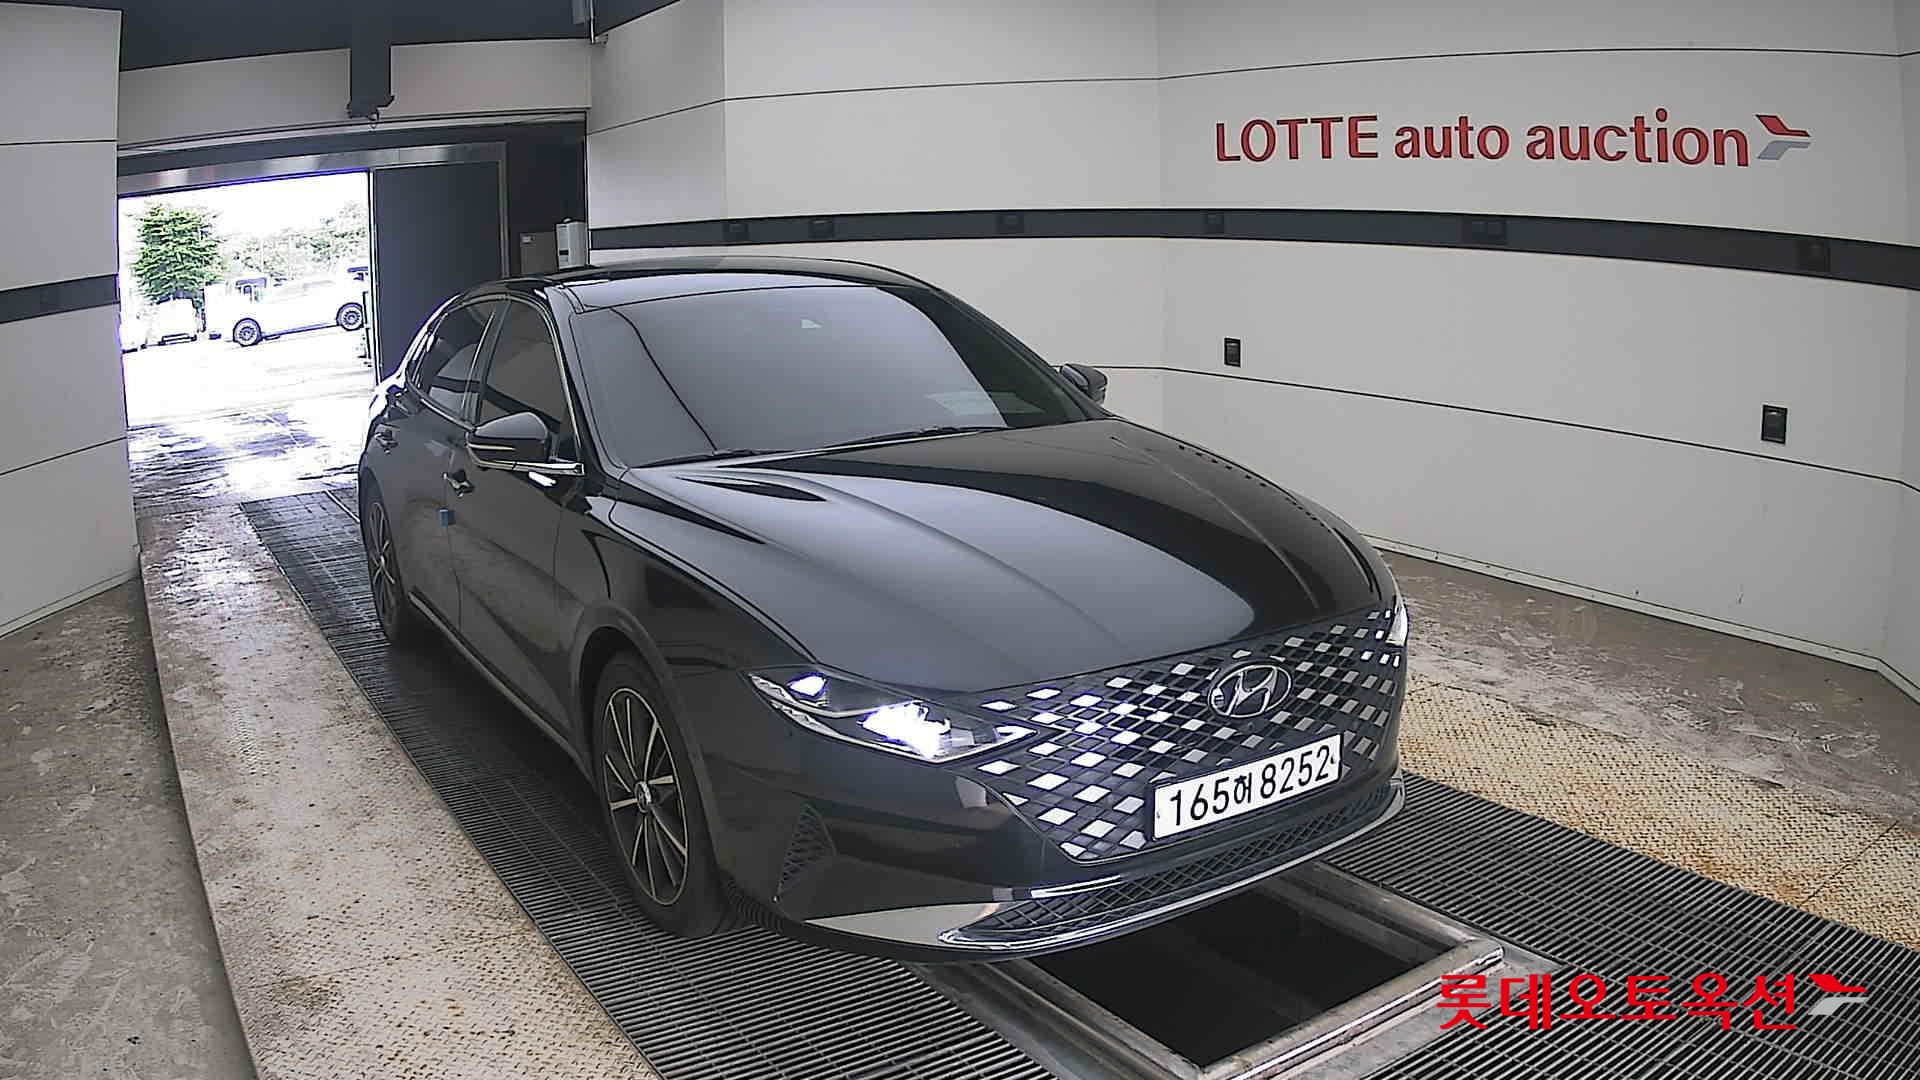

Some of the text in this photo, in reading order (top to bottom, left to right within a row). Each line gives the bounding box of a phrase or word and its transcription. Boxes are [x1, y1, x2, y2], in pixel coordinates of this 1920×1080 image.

[1215, 107, 1750, 167] LOTTE auto auction
[1170, 745, 1331, 826] 165허 8252
